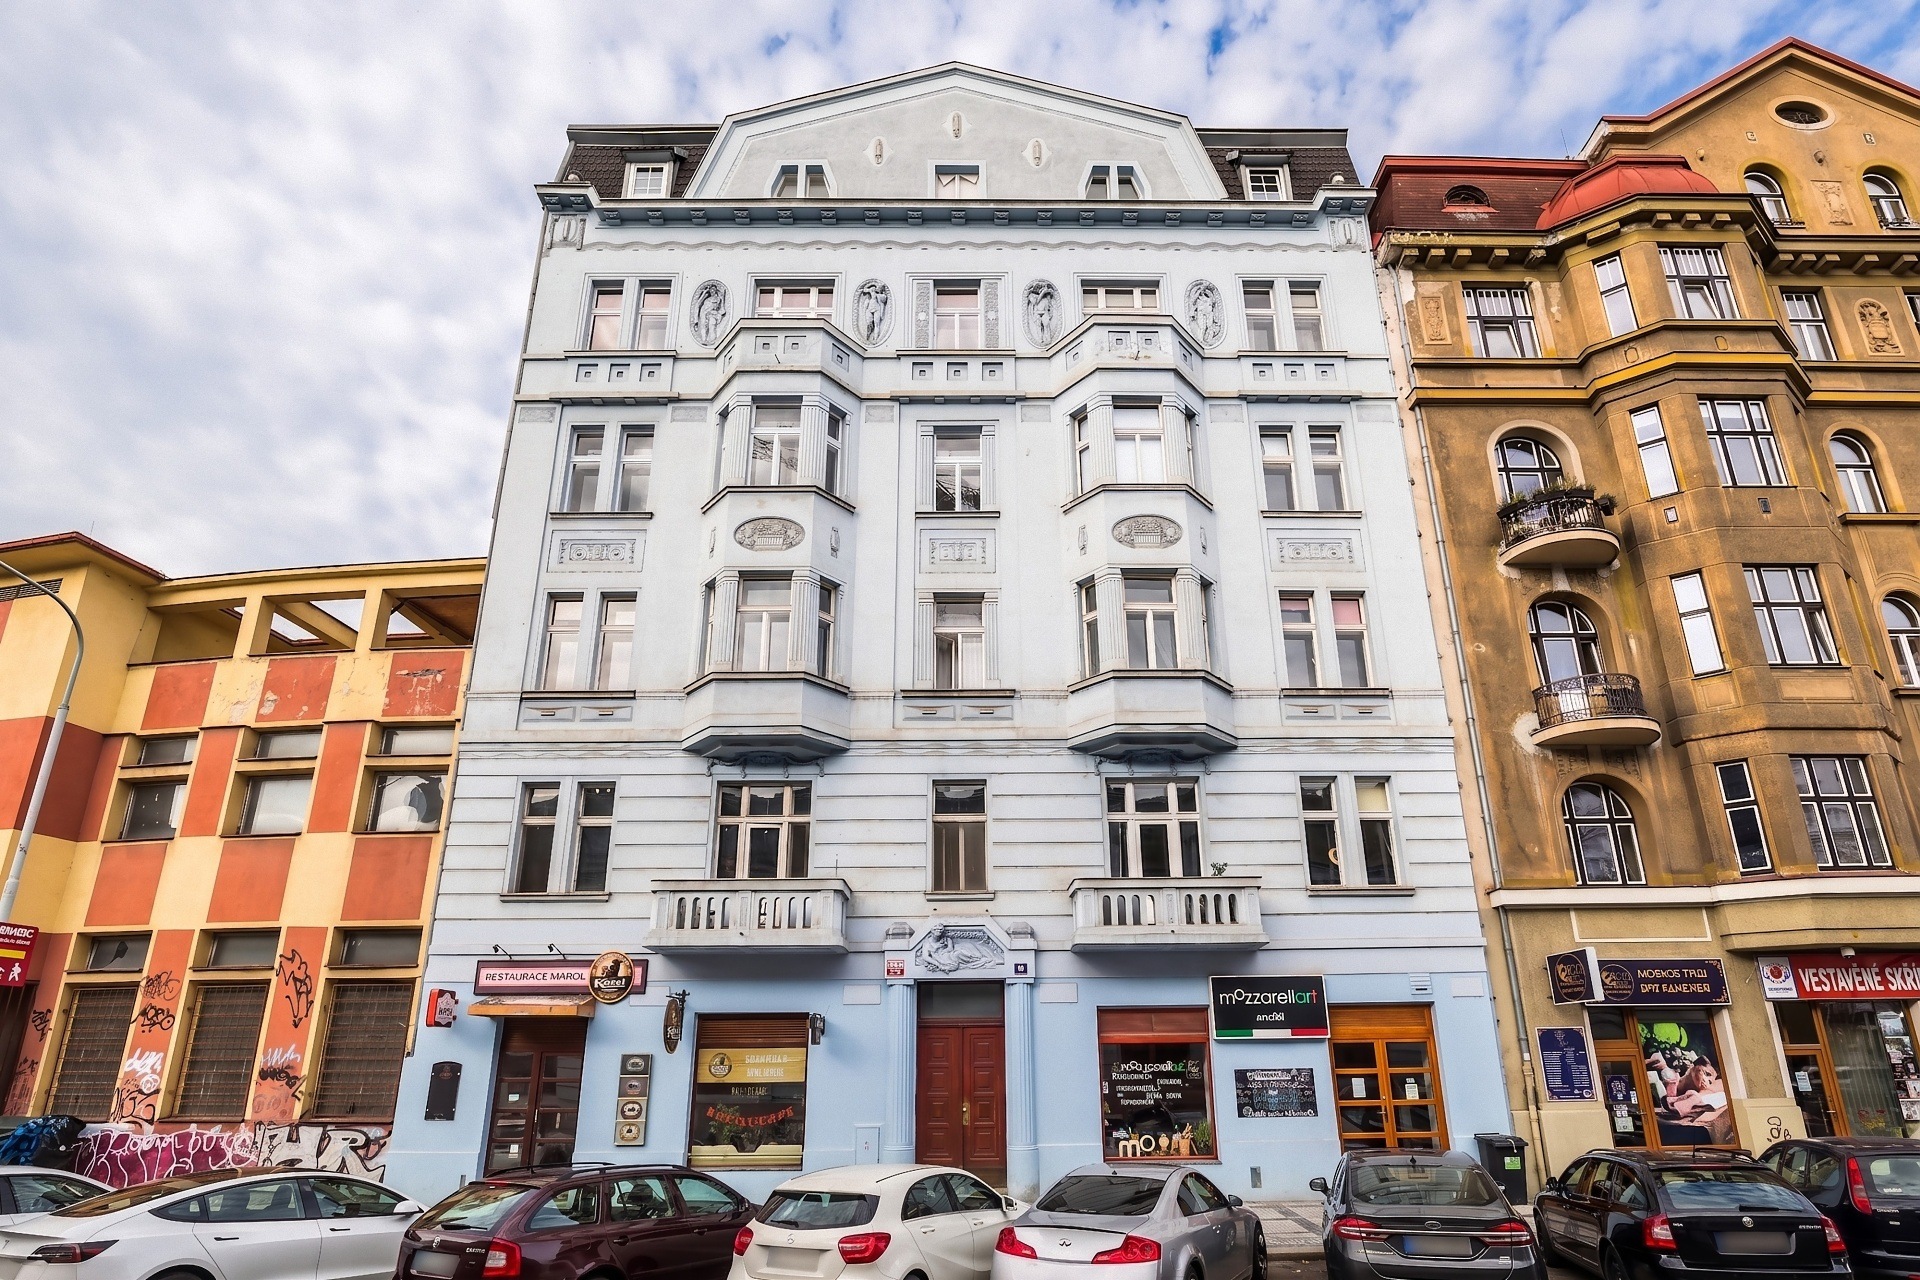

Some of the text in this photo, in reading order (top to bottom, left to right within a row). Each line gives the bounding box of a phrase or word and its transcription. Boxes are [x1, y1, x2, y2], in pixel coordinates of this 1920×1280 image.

[485, 972, 586, 981] RESTAURACE MAROL
[1798, 962, 1920, 992] VESTAVĚNÉ SKŘÍ
[1219, 988, 1318, 1005] mozzarellart
